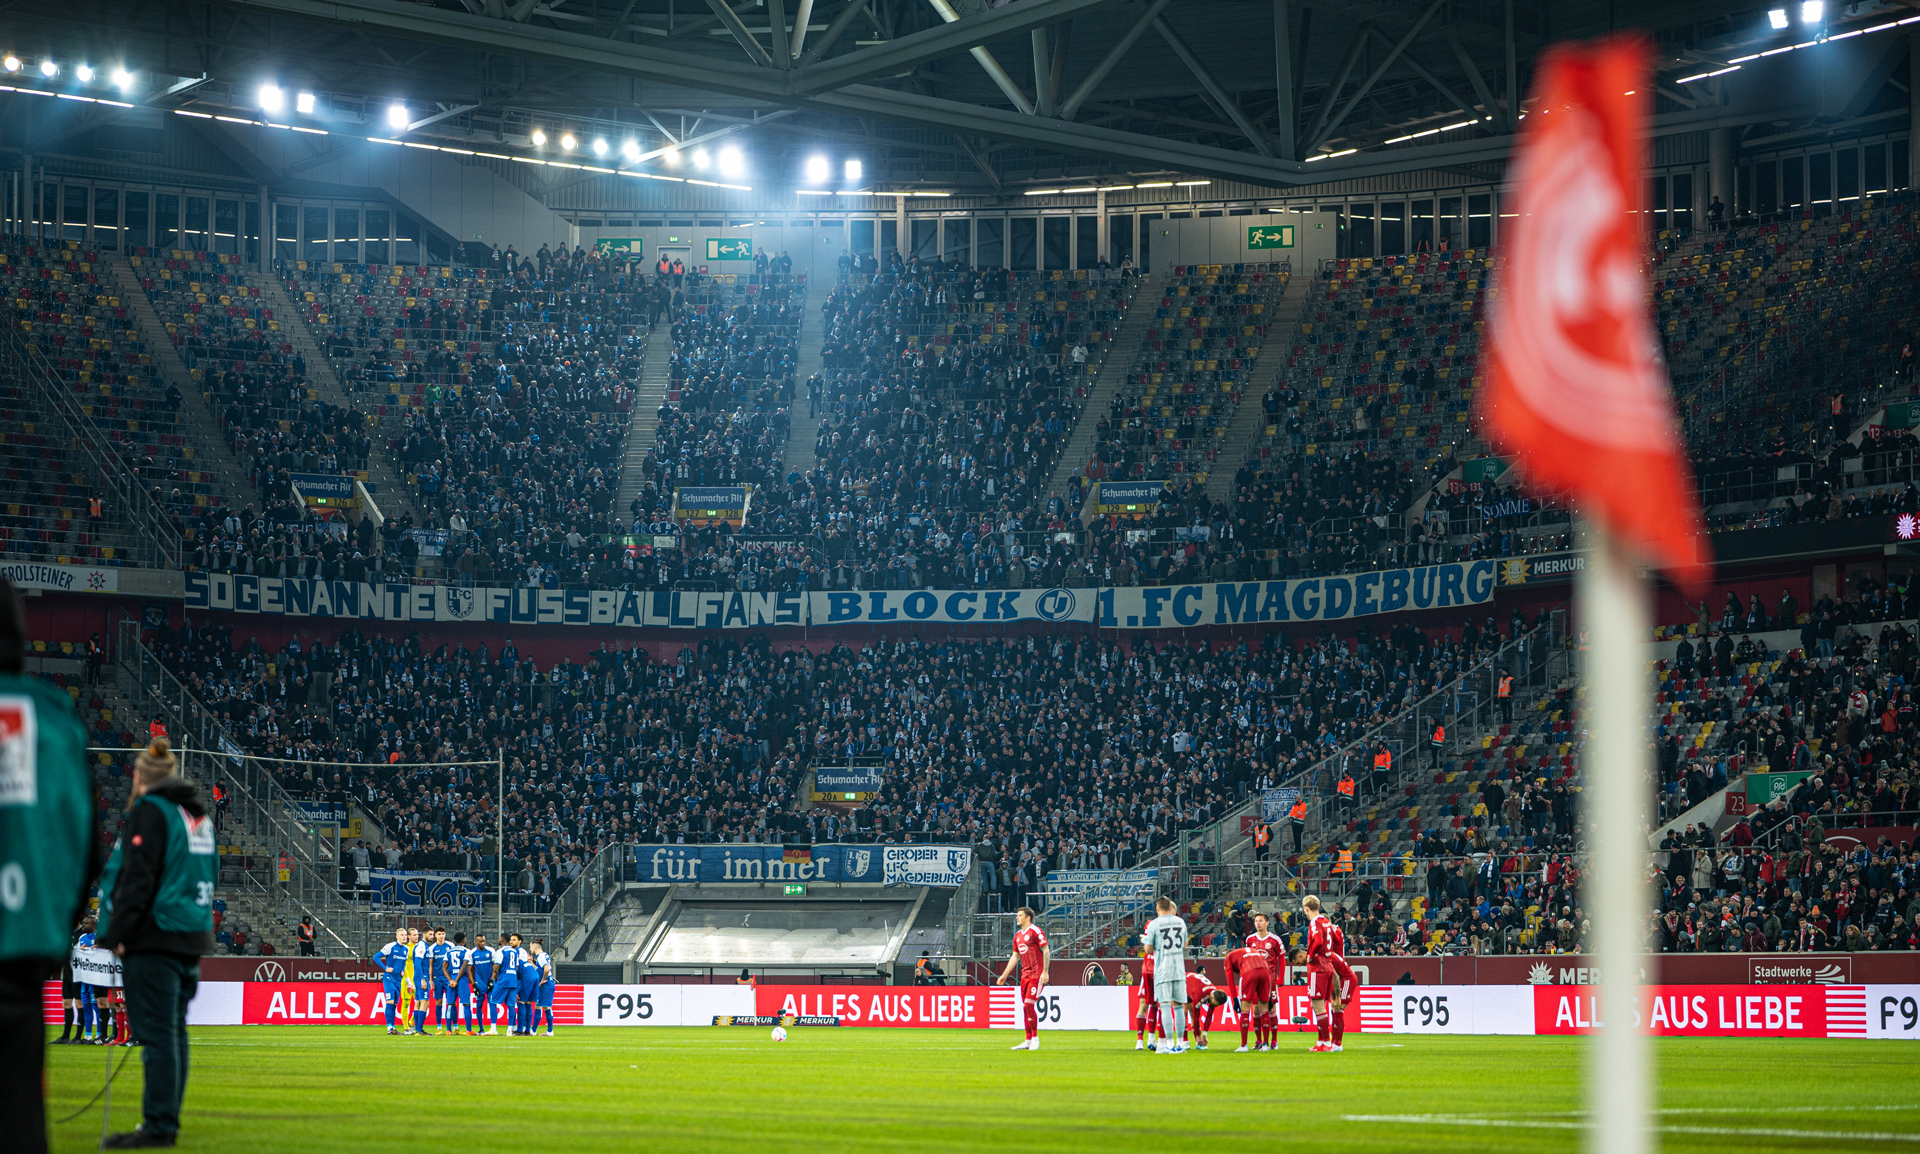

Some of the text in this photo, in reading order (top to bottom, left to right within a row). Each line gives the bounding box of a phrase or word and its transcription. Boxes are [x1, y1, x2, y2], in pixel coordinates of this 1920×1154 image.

[334, 498, 352, 507] 126
[682, 493, 743, 504] Schumacher Alt
[1102, 488, 1148, 499] Schumacher
[685, 509, 739, 518] 127 128
[1533, 557, 1585, 575] MERKUR
[185, 571, 435, 621] SOGENANNTE
[1214, 559, 1494, 625] MAGDEBURG
[486, 588, 804, 627] FUSSBALLFANS
[827, 590, 1021, 621] BLOCK
[817, 774, 869, 786] Schumacher
[1731, 795, 1745, 812] 23
[334, 809, 347, 821] Alt
[650, 847, 830, 880] für immer
[886, 872, 965, 884] MAGDEBURG
[381, 876, 478, 909] 1965
[1085, 883, 1154, 900] MAGDEBURG
[1159, 927, 1183, 950] 33
[1326, 927, 1332, 950] 5
[72, 956, 124, 974] #WeRemembe
[450, 950, 461, 968] 15
[509, 951, 516, 969] 8
[298, 971, 341, 980] MOLL
[1754, 965, 1812, 978] Stadtwerke
[1030, 986, 1037, 995] 9
[266, 991, 361, 1019] ALLES
[597, 993, 654, 1020] F95
[781, 994, 976, 1023] ALLES AUS LIEBE
[1037, 995, 1062, 1023] 95
[1403, 995, 1450, 1026] F95
[1650, 995, 1709, 1029] AUS
[1718, 996, 1803, 1030] LIEBE
[736, 1016, 835, 1025] MERKUR MERKUR
